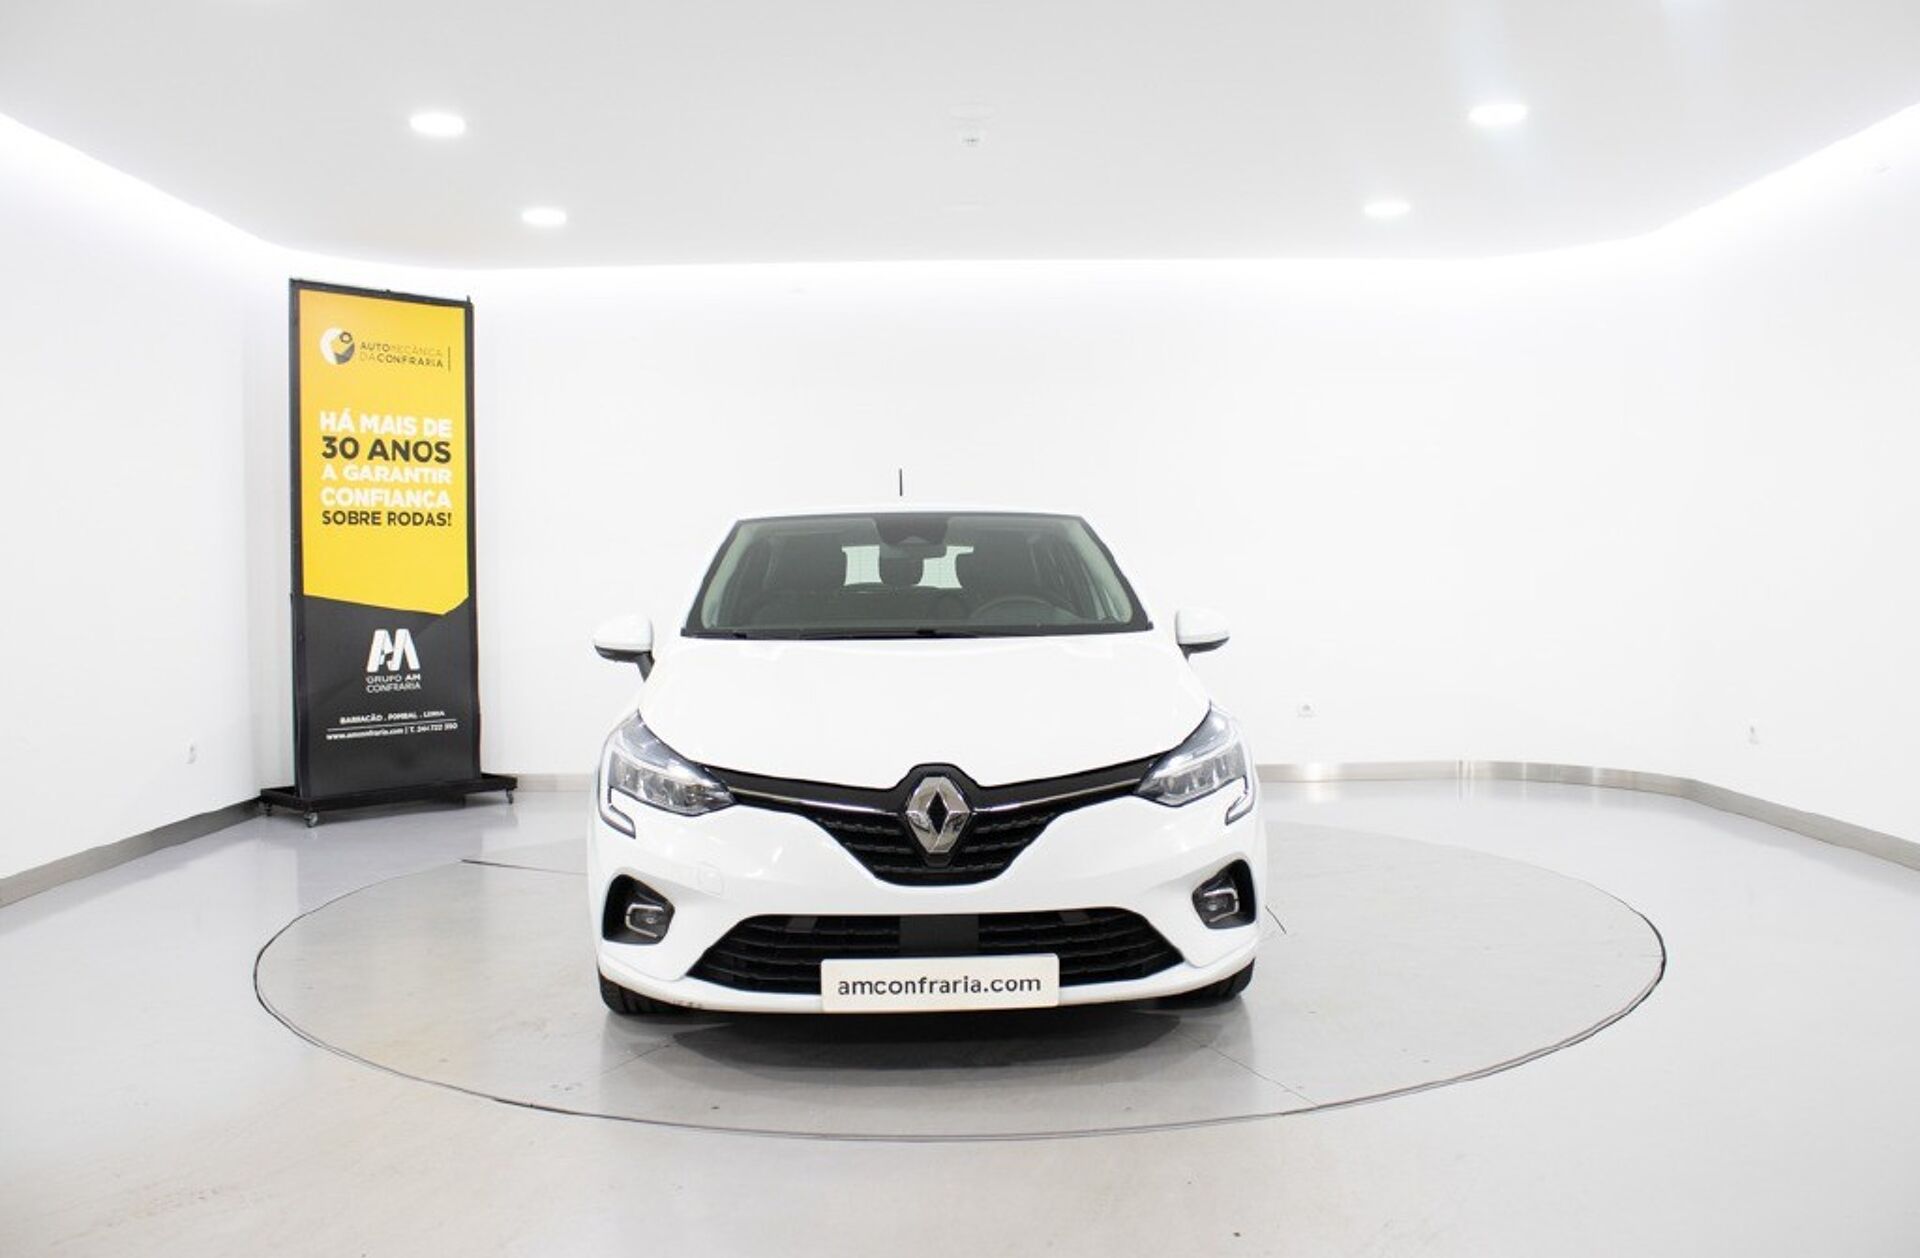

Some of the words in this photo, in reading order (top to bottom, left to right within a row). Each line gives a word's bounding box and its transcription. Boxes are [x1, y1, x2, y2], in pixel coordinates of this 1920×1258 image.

[320, 408, 355, 433] HÁ
[360, 414, 417, 436] MAIS
[423, 418, 452, 438] DE
[321, 436, 360, 460] 30
[367, 438, 452, 464] ANOS
[321, 464, 337, 481] A
[342, 464, 452, 484] GARANTIR
[321, 510, 382, 526] SOBRE
[387, 511, 452, 527] RODAS!
[365, 674, 402, 685] GRUPO
[365, 681, 421, 694] CONFRARIA
[837, 975, 1042, 996] amconfraria.com
